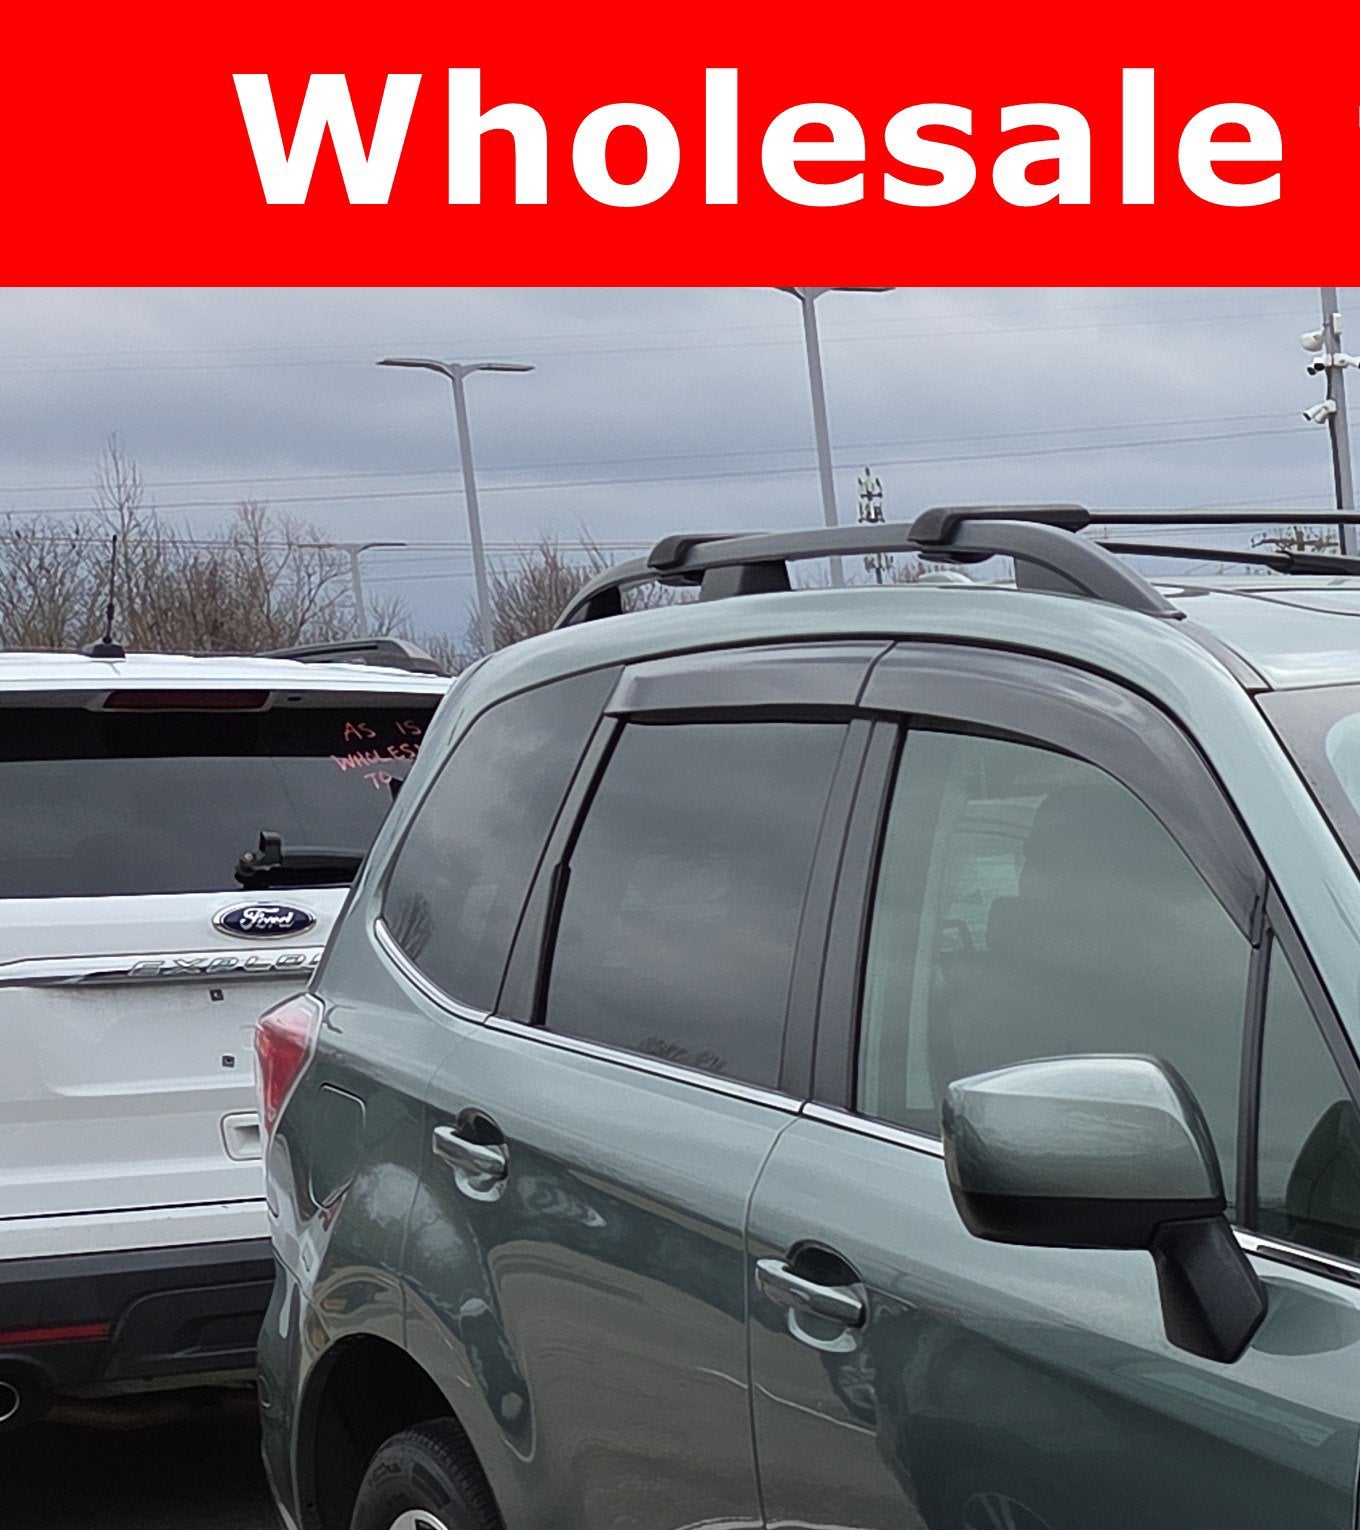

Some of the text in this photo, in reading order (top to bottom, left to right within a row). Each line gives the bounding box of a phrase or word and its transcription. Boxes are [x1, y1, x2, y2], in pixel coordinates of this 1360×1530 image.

[344, 719, 422, 742] AS IS
[239, 907, 294, 930] Ford
